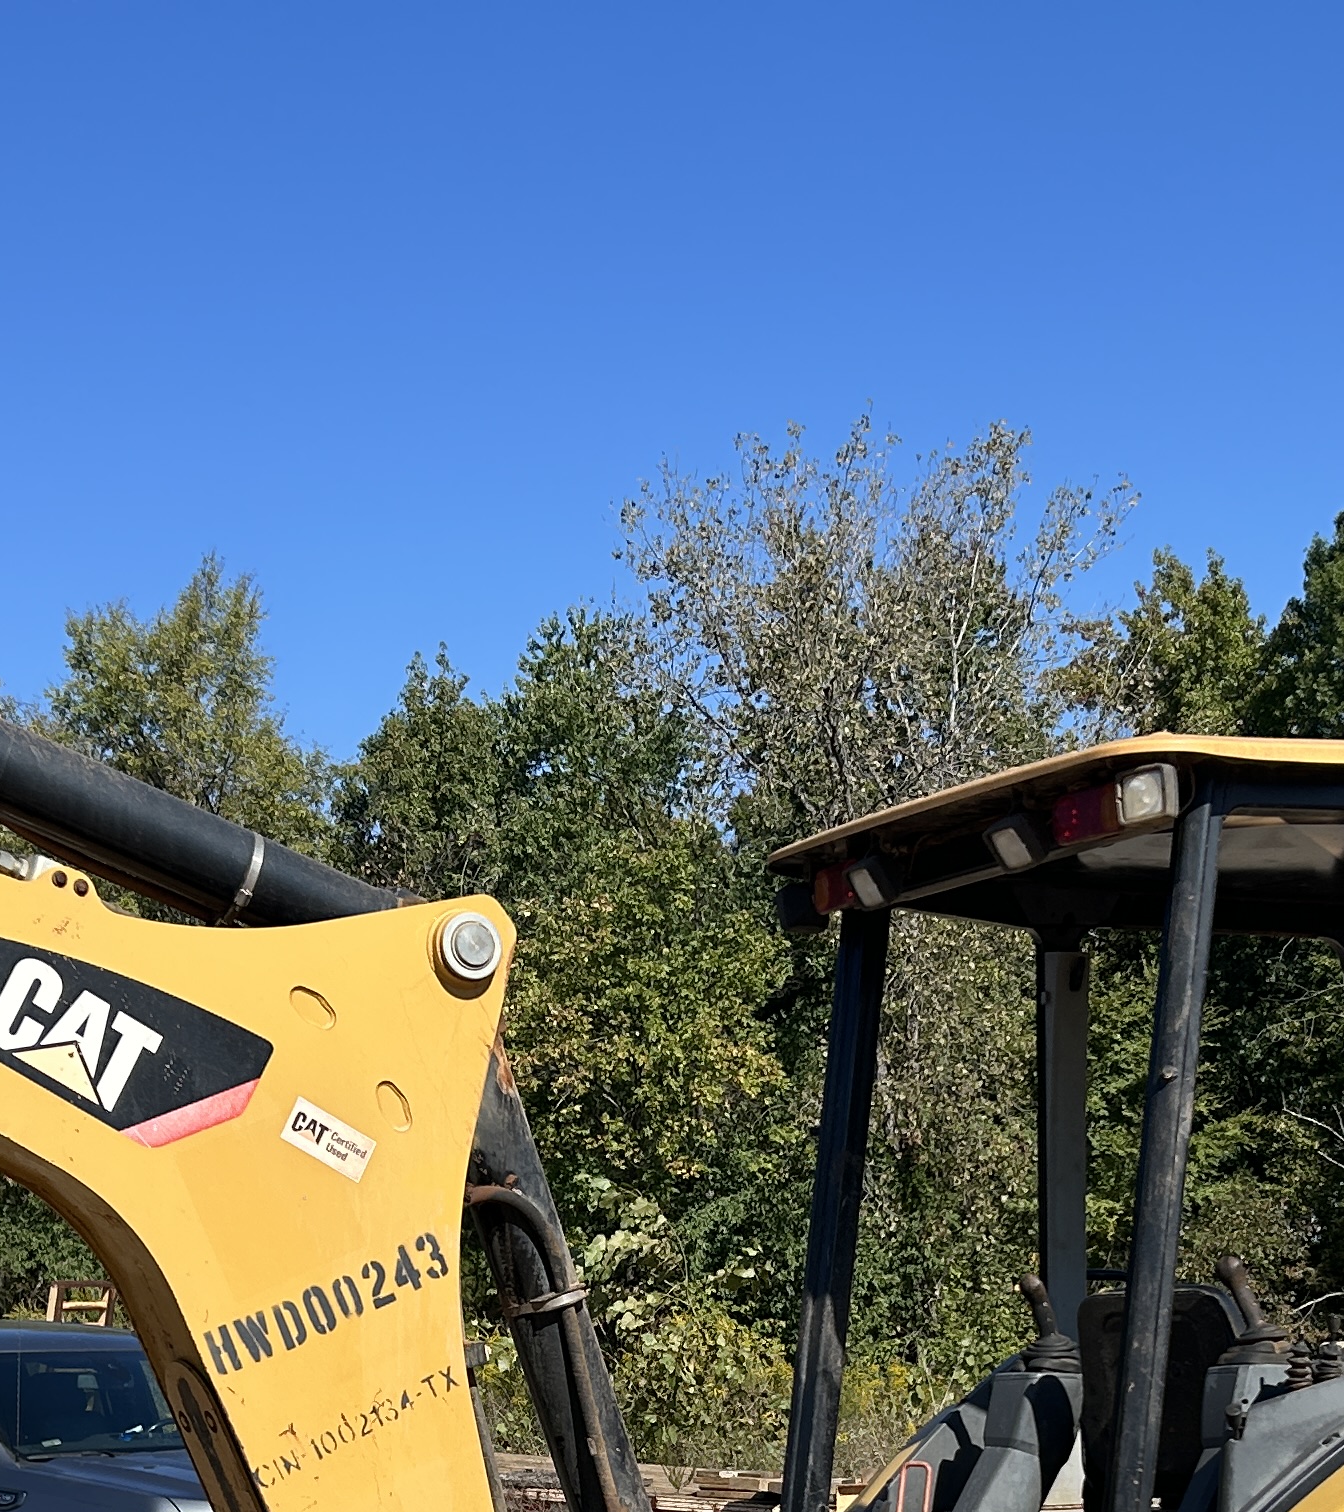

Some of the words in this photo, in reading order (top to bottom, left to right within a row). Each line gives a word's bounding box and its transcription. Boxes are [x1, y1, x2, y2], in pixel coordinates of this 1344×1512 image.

[292, 1111, 329, 1145] CAT
[331, 1132, 367, 1159] Certified
[326, 1142, 348, 1161] Used
[203, 1232, 448, 1375] HWD00243
